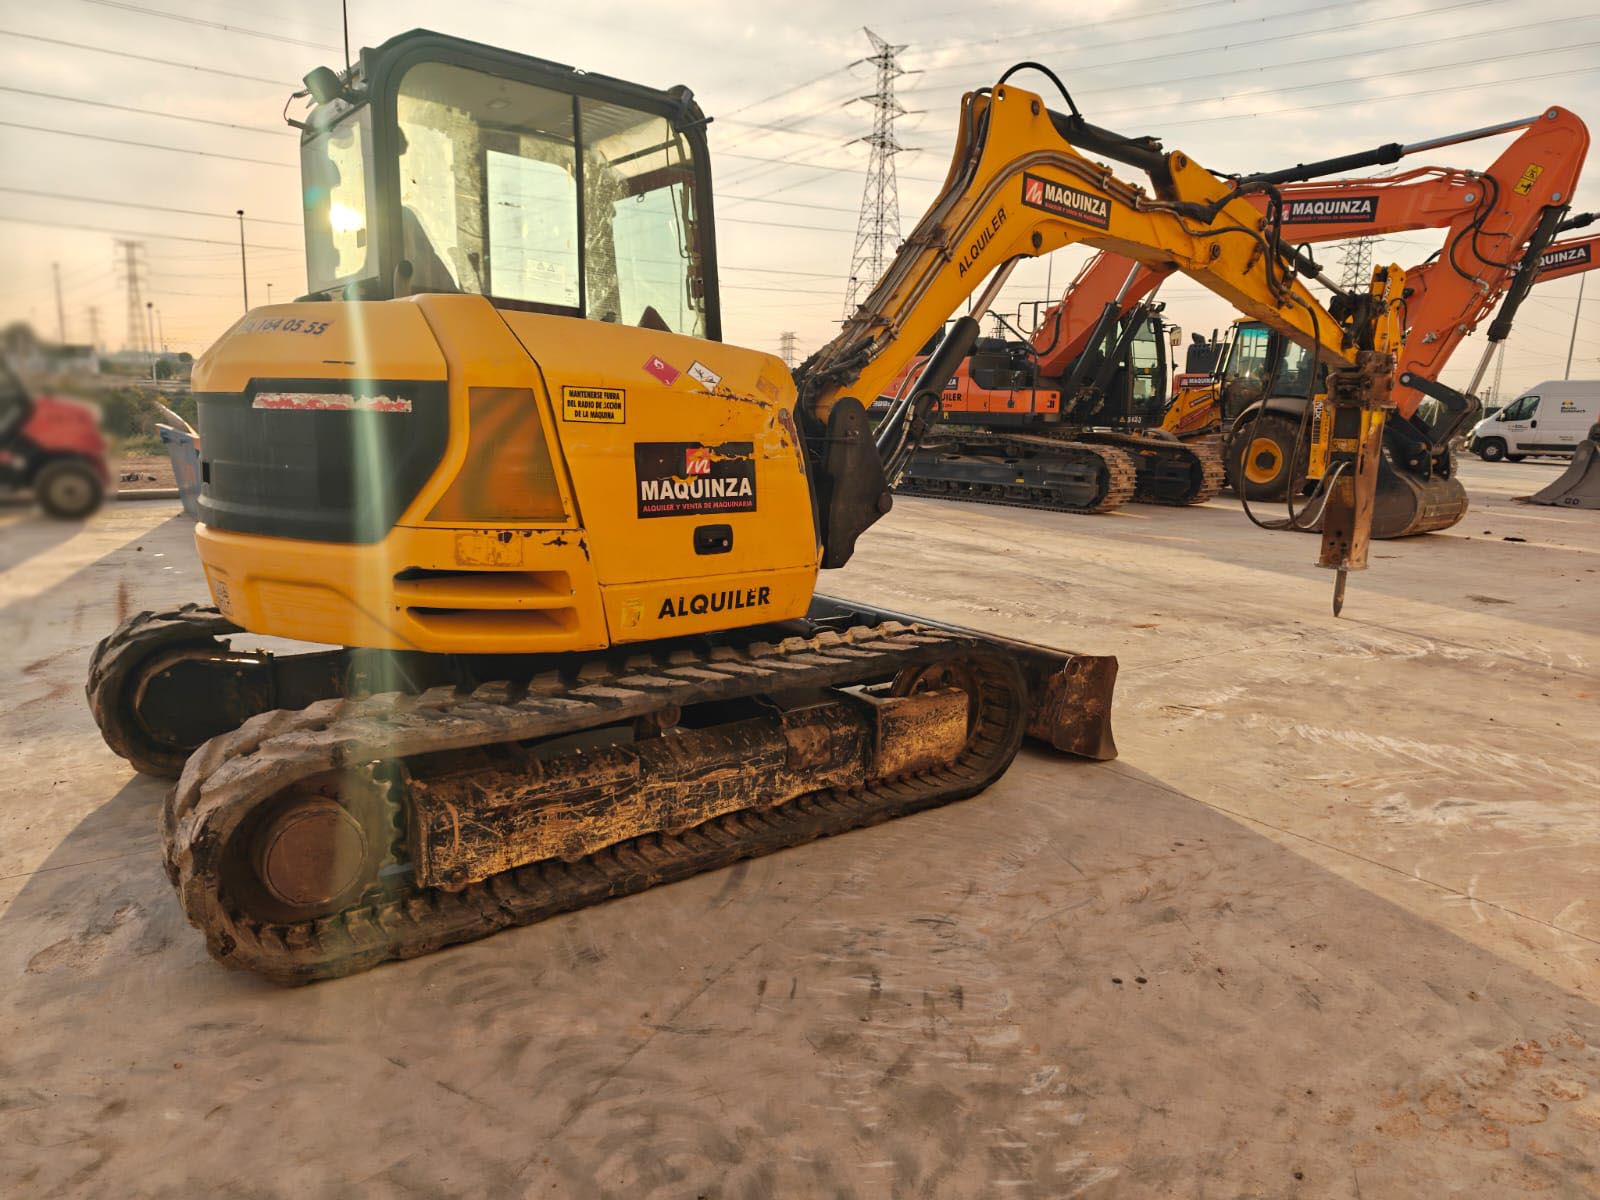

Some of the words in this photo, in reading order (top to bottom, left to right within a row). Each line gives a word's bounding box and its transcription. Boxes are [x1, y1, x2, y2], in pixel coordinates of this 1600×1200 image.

[1045, 183, 1107, 218] MAQUINZA
[1292, 199, 1371, 215] MAQUINZA
[959, 207, 1007, 278] ALQUILER
[1540, 248, 1586, 267] QUINZA
[304, 321, 329, 335] 55
[569, 390, 602, 399] MANTENERSE
[604, 391, 620, 400] FUERA
[578, 400, 595, 408] RADIO
[596, 401, 602, 409] DE
[575, 410, 581, 418] DE
[583, 410, 589, 418] LA
[641, 477, 752, 501] MAQUINZA
[643, 504, 674, 512] ALQUILER
[713, 500, 753, 508] MAQUINARIA
[657, 586, 771, 619] ALQUILER
